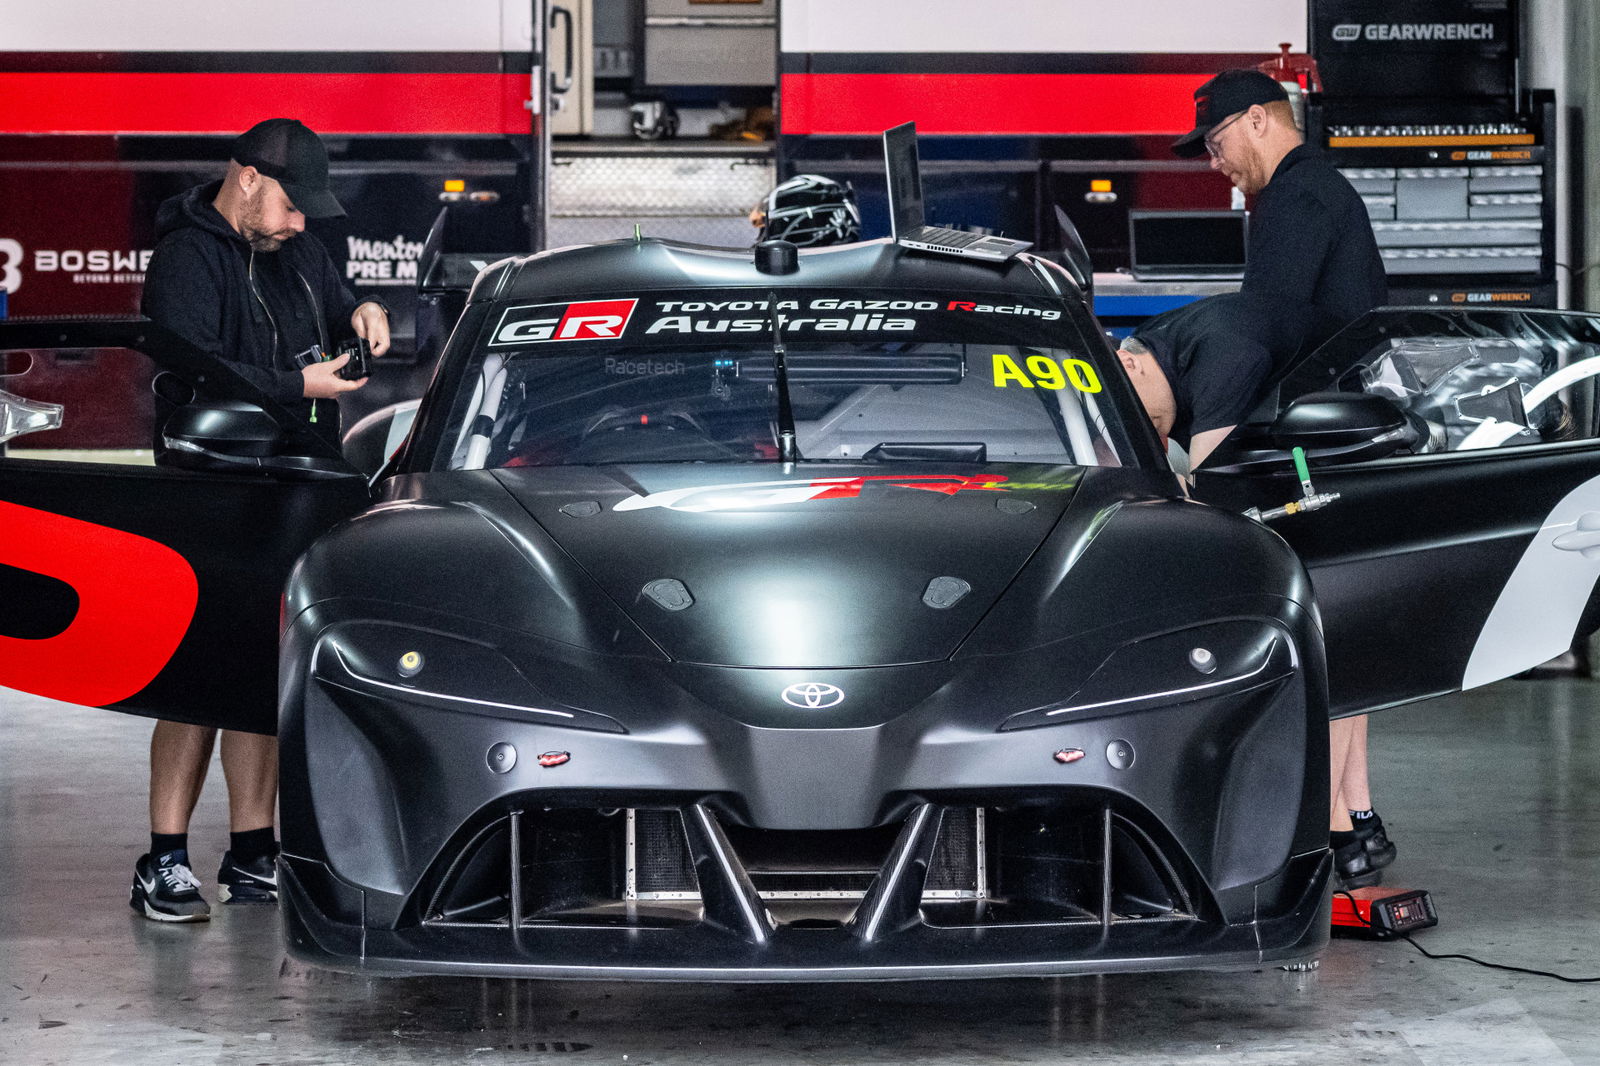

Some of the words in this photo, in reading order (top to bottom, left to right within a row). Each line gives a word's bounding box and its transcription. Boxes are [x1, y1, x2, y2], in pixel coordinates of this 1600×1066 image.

[1364, 23, 1494, 40] GEARWRENCH
[1467, 151, 1531, 160] GEARWRENCH
[346, 261, 393, 279] PRE
[1467, 293, 1531, 302] GEARWRENCH
[656, 300, 799, 312] TOYOTA
[809, 299, 938, 311] GAZOO
[947, 301, 1062, 320] Racing
[498, 315, 624, 342] GR
[645, 313, 917, 334] Australia
[604, 357, 685, 376] Racetech
[992, 354, 1103, 394] A90
